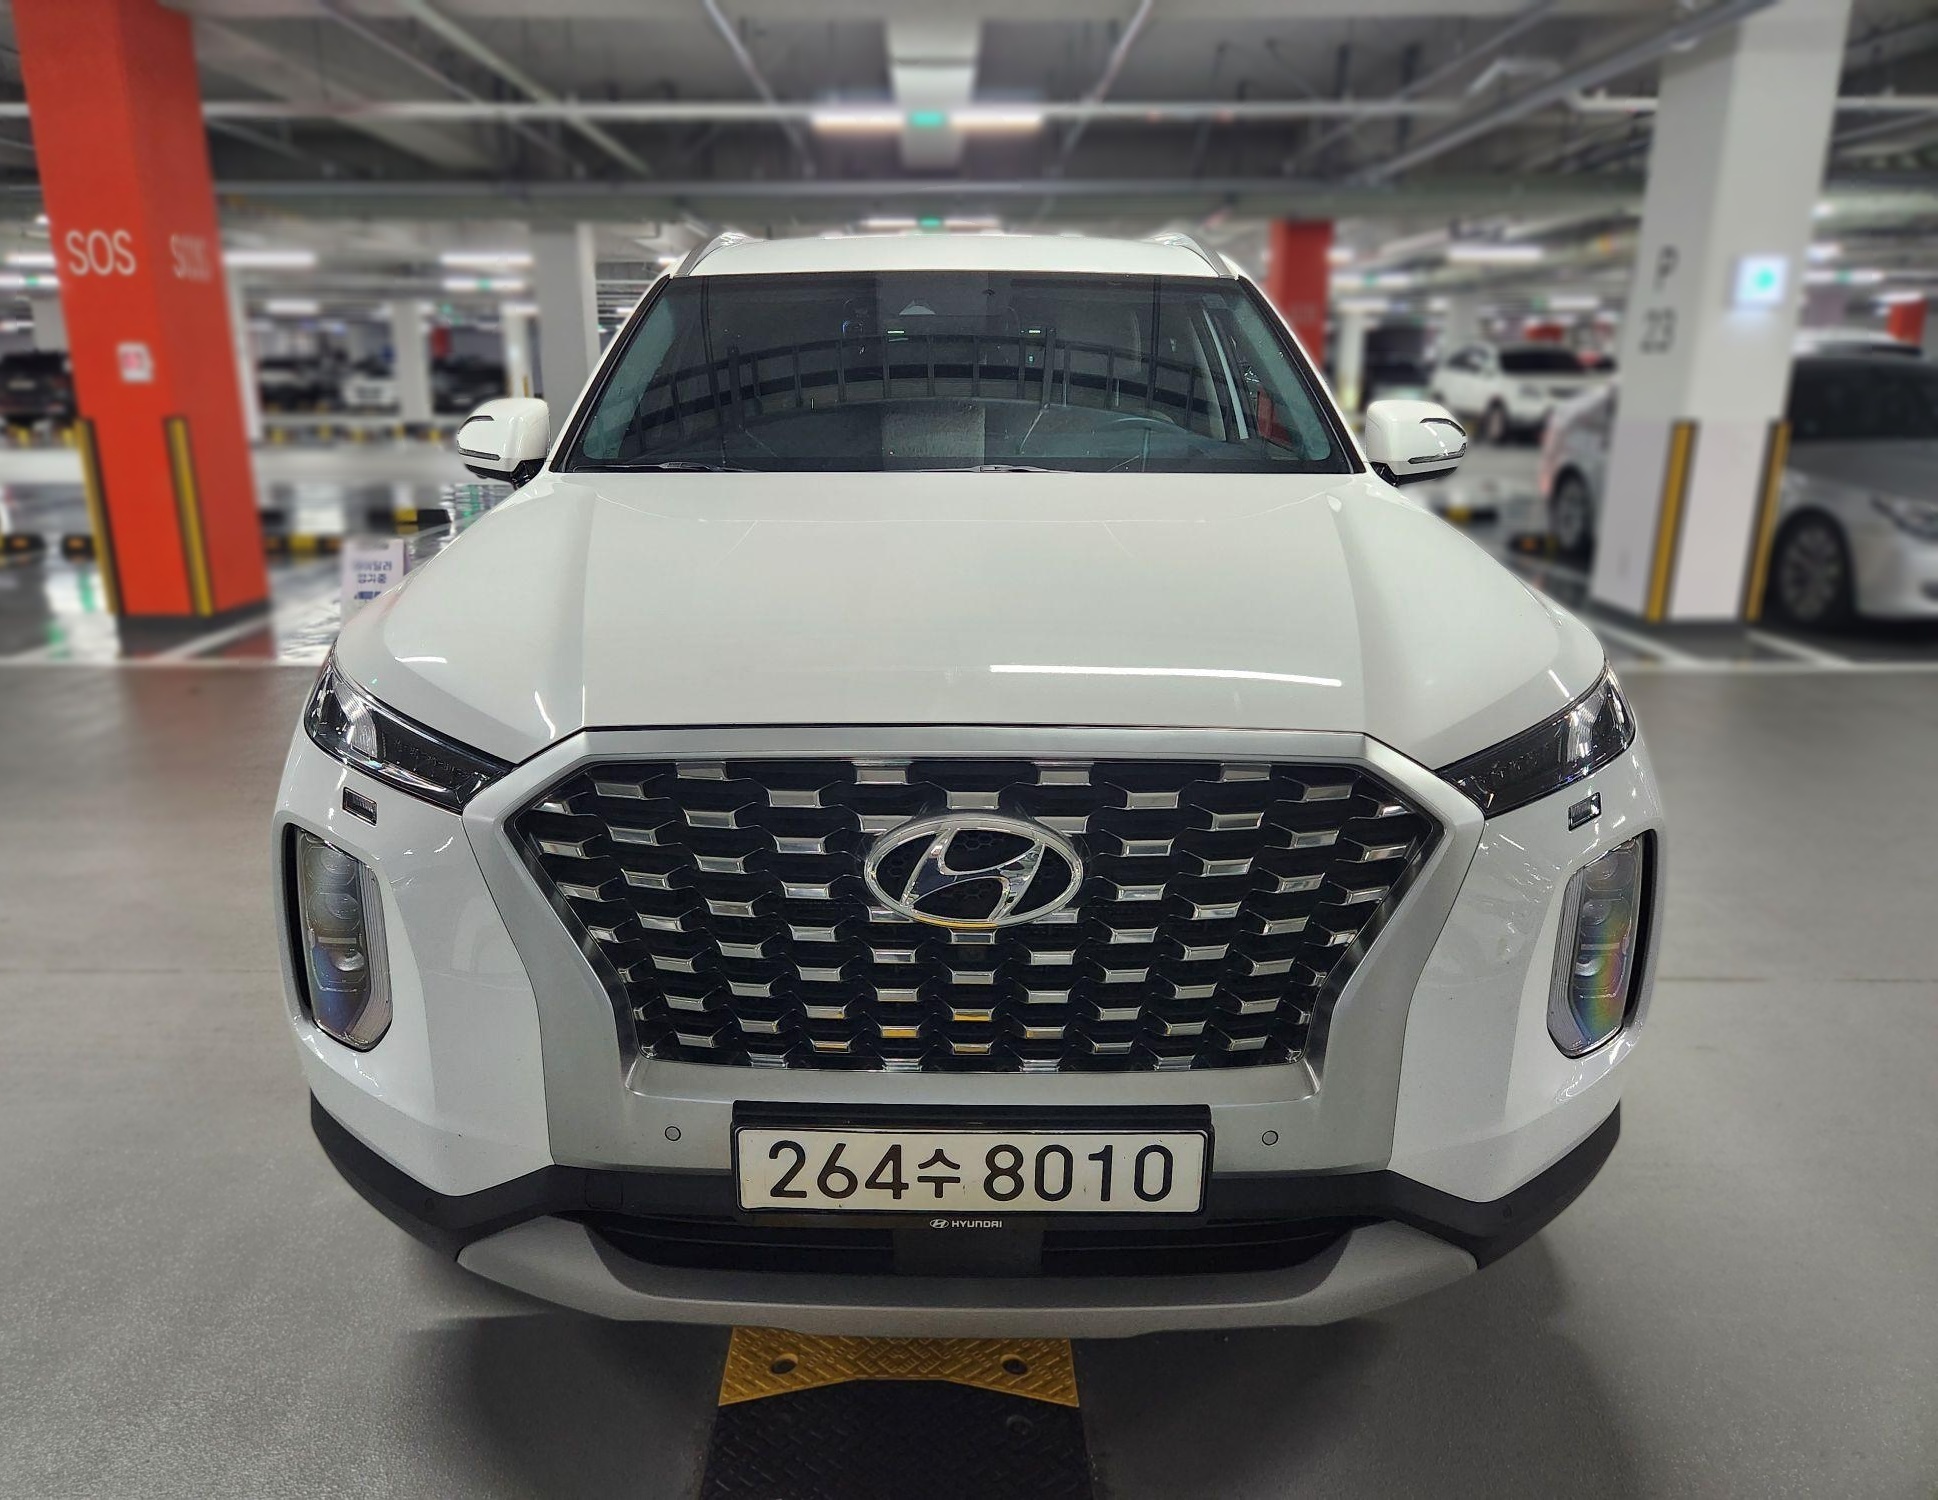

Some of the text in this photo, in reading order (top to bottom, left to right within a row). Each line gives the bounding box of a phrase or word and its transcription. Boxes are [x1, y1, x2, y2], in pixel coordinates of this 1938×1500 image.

[66, 230, 136, 276] SOS
[768, 1140, 1174, 1202] 264수 8010
[951, 1220, 1002, 1228] HYUNDAI
